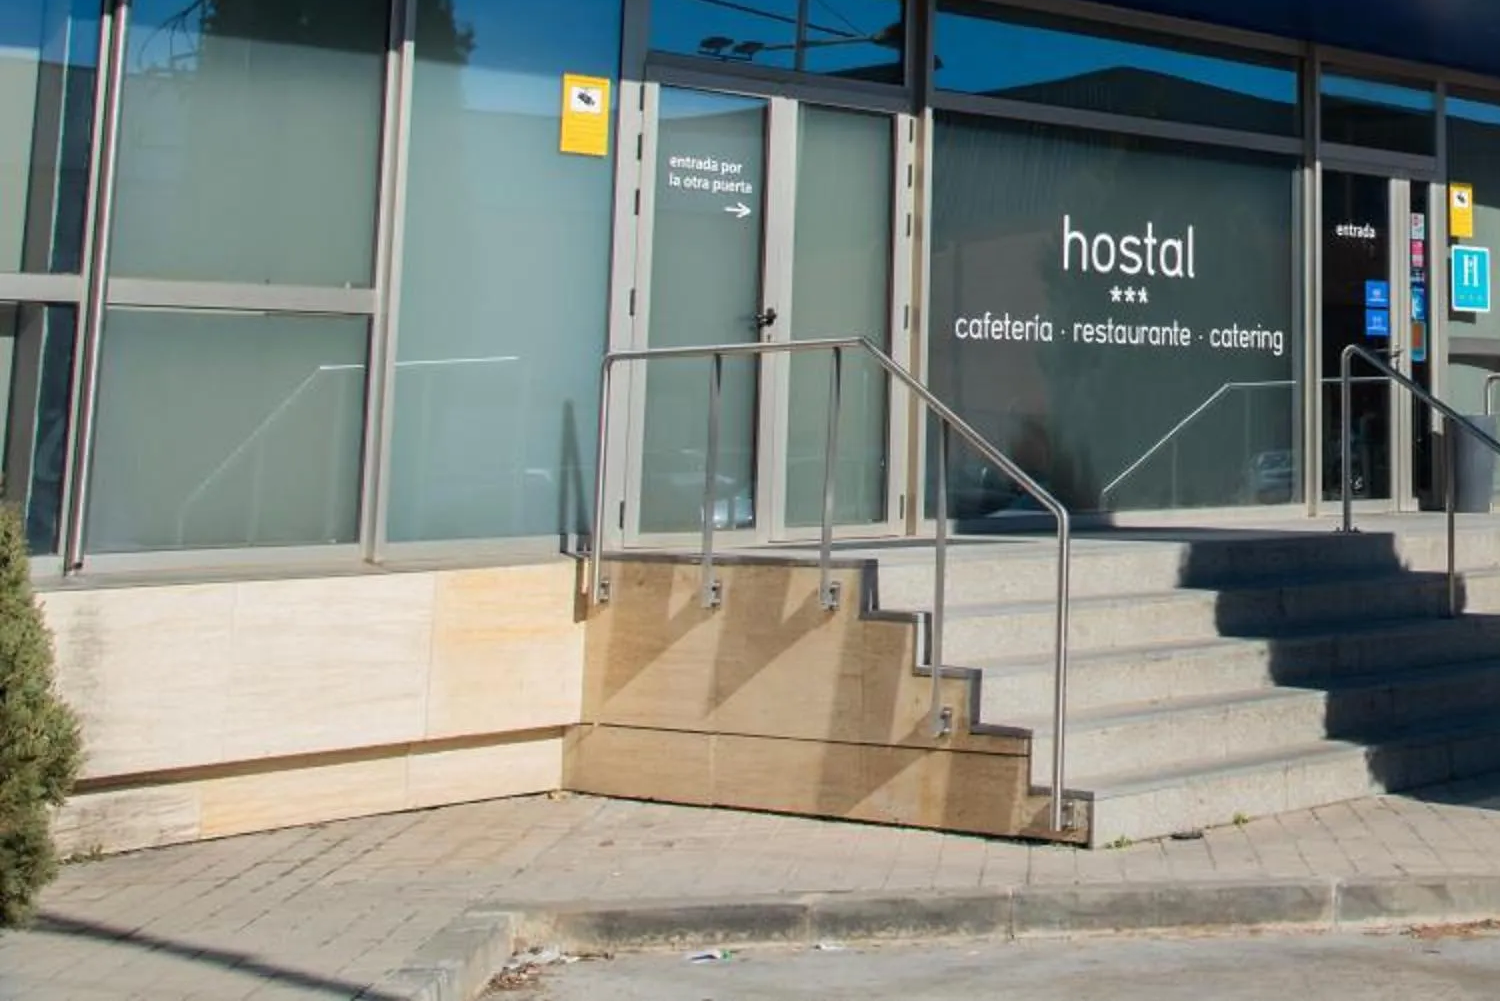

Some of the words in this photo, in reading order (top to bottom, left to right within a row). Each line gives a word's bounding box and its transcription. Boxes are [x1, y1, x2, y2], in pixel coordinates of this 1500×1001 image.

[669, 155, 719, 172] entrada
[720, 162, 743, 176] por
[669, 171, 681, 187] la
[683, 174, 710, 190] otra
[712, 178, 753, 194] puerta
[1336, 223, 1376, 239] entrada
[1062, 214, 1195, 279] hostal
[1073, 318, 1191, 346] restaurante
[1209, 324, 1284, 356] catering
